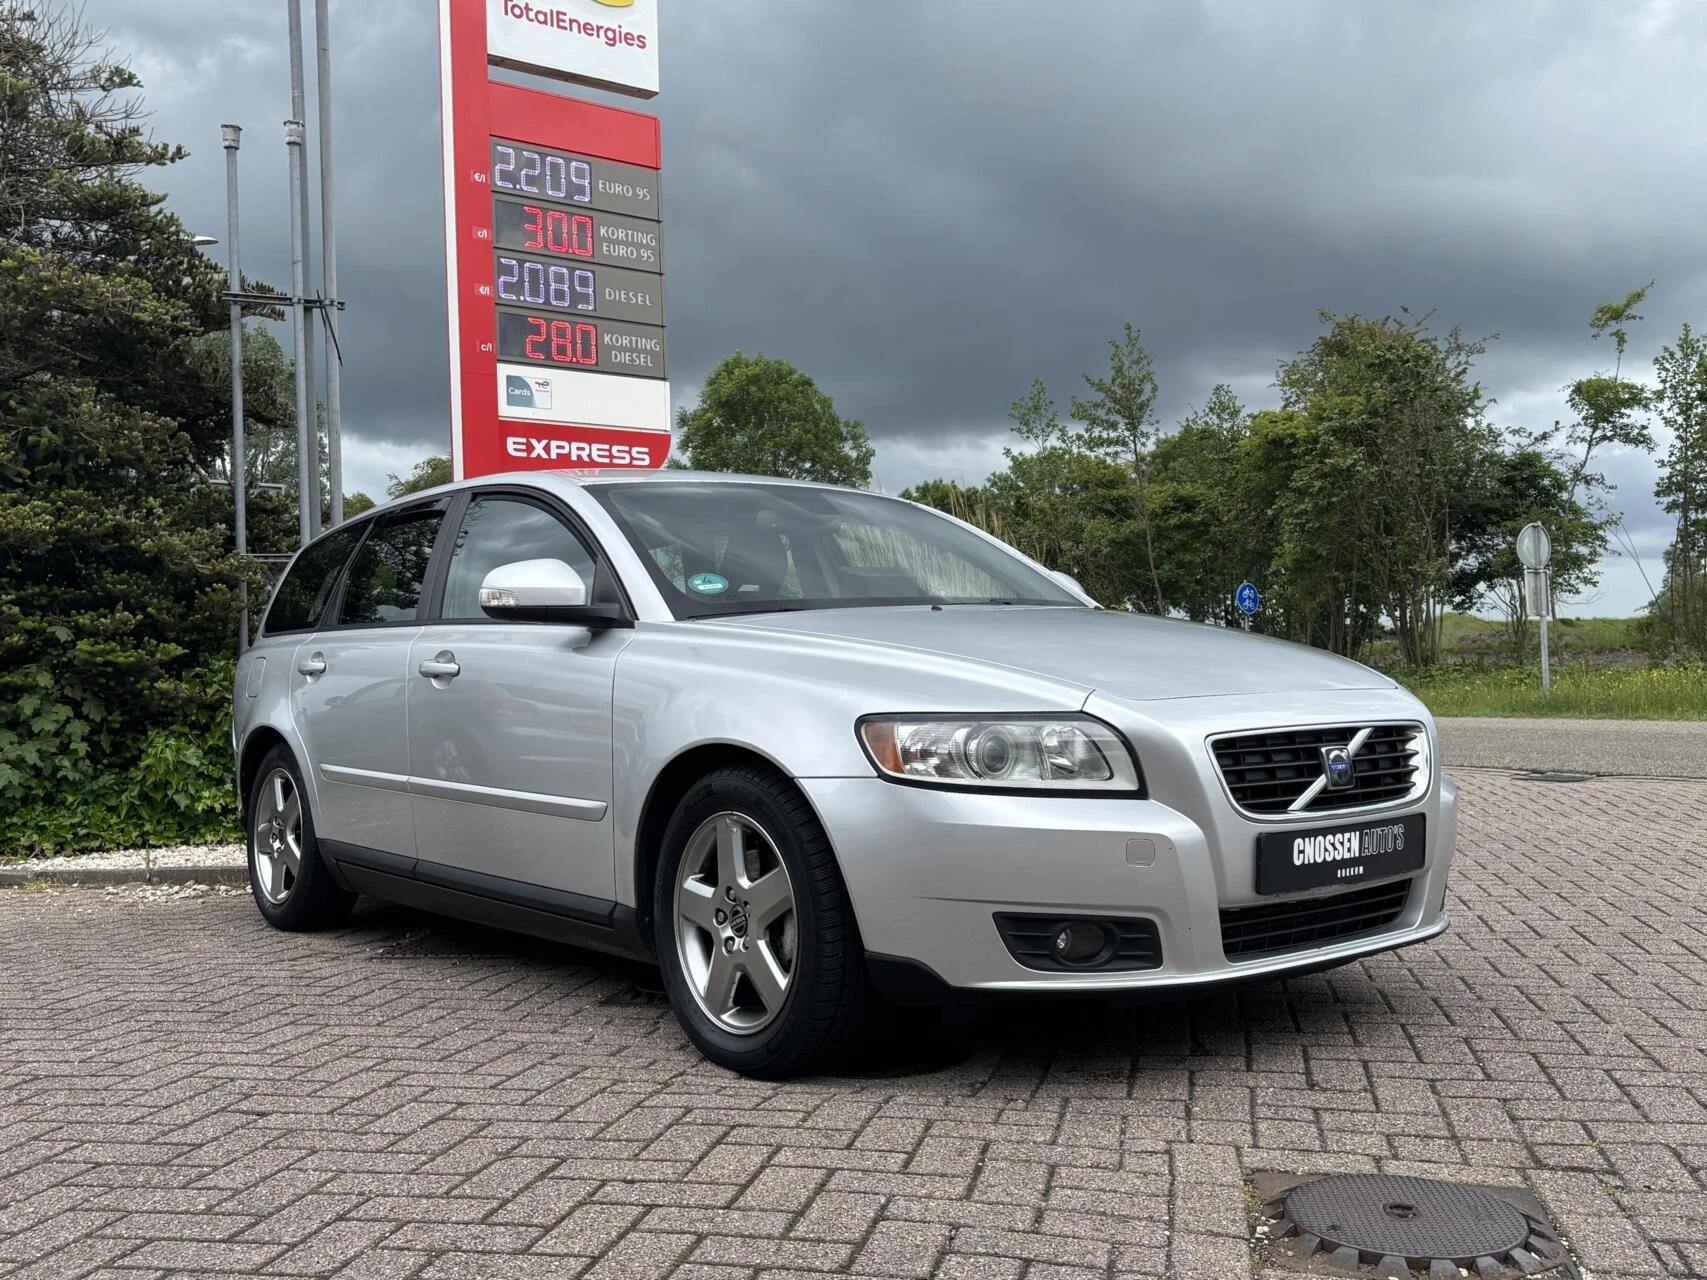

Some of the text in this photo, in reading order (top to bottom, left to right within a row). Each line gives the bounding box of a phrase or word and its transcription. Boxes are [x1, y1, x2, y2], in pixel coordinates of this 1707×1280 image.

[503, 0, 647, 49] TotalEnergies
[494, 145, 591, 202] 2.209
[598, 179, 651, 201] EURO 95
[599, 225, 656, 247] KORTING
[602, 242, 655, 262] EURO 95
[498, 257, 595, 310] 2.089
[605, 288, 653, 306] DIESEL
[526, 317, 597, 365] 28.0
[603, 333, 660, 351] KORTING
[611, 350, 654, 367] DIESEL
[508, 387, 531, 396] Cards
[506, 436, 650, 466] EXPRESS
[1293, 824, 1405, 866] CNOSSEN AUTO'S
